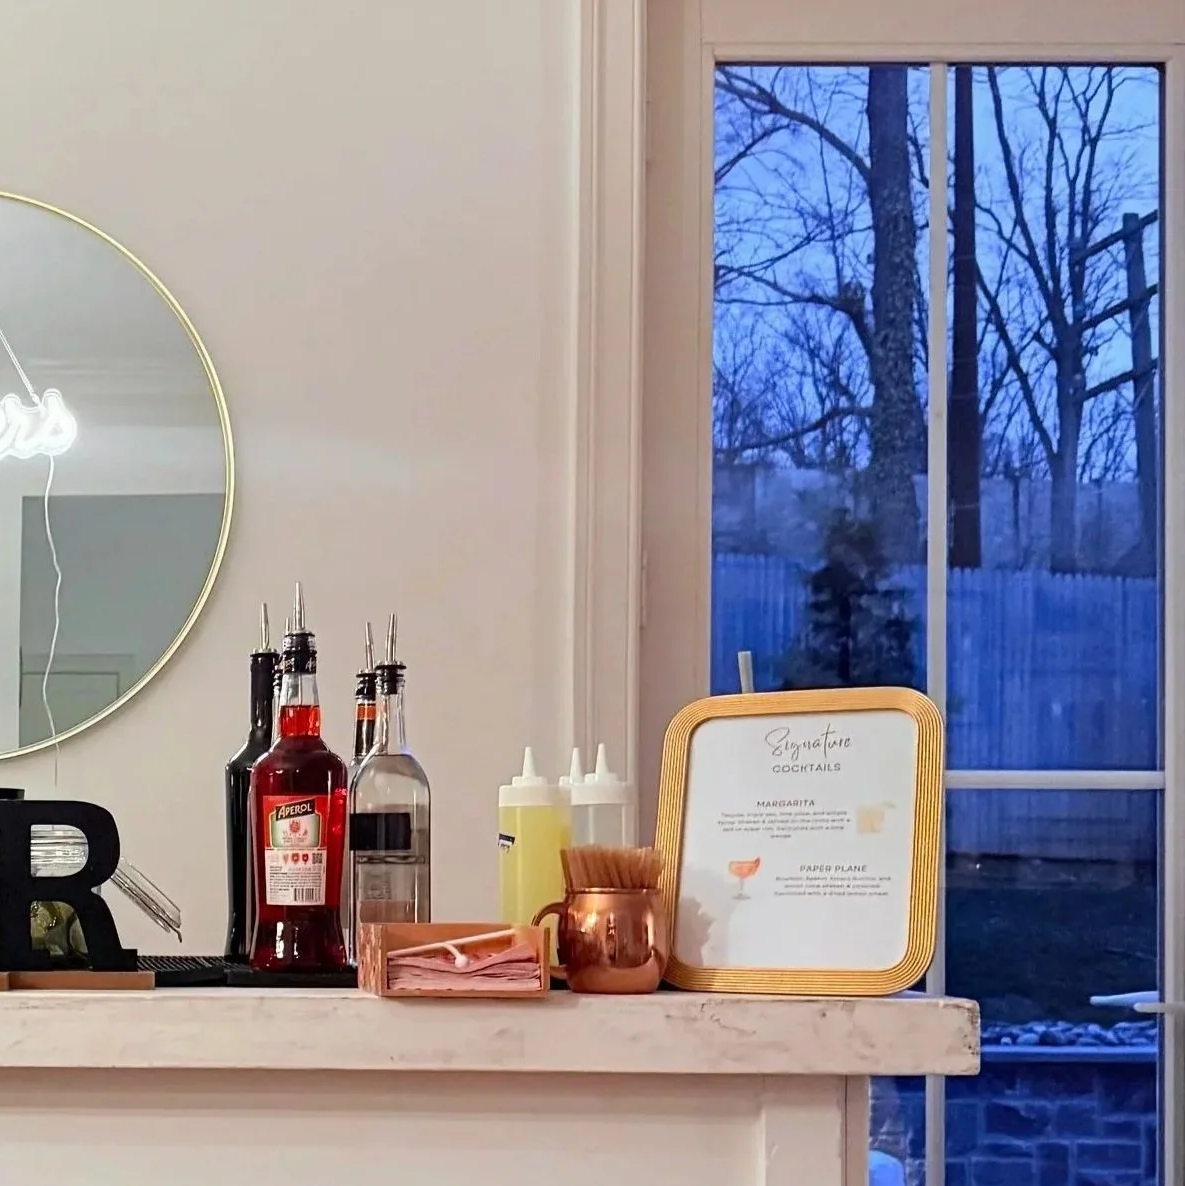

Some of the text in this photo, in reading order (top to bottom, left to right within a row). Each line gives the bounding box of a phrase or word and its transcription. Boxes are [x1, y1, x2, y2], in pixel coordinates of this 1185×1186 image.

[765, 723, 851, 761] Signature
[772, 763, 841, 773] COCKTAILS
[756, 799, 815, 808] MARGARITA
[277, 802, 313, 819] APEROL
[799, 864, 867, 872] PAPER PLANE
